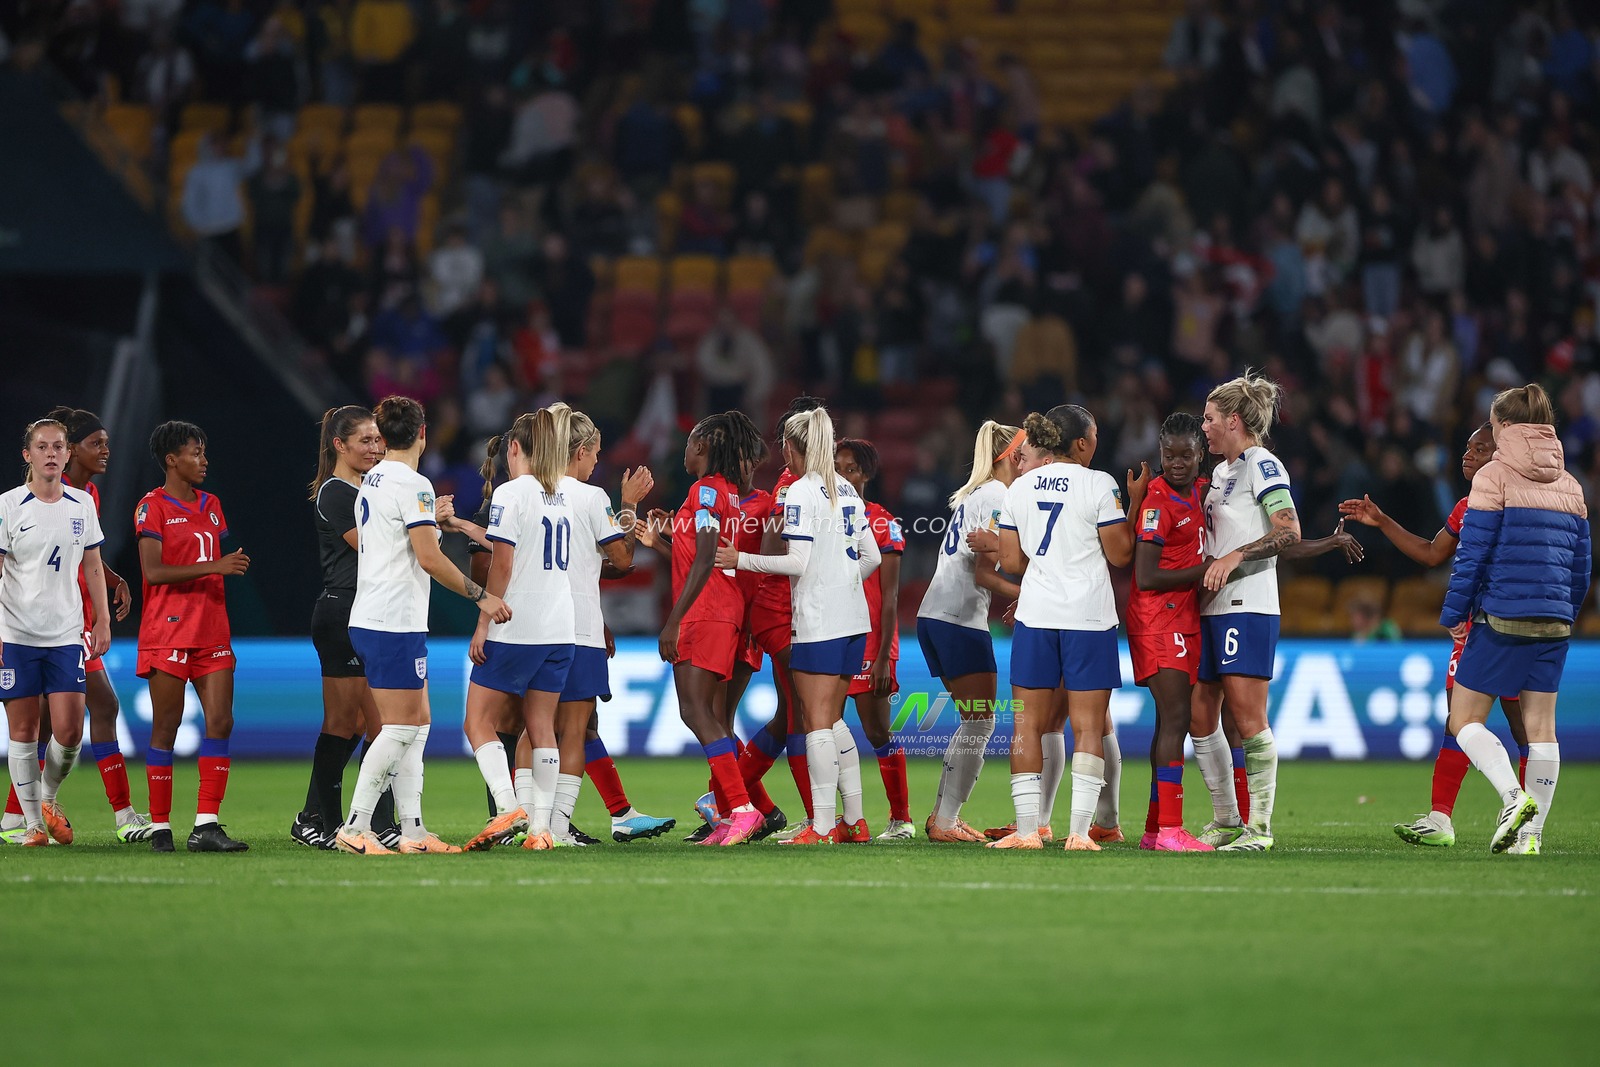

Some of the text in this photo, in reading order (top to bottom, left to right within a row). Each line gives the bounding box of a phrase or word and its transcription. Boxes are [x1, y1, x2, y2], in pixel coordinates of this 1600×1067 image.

[1034, 476, 1069, 492] JAMES
[541, 515, 571, 571] 10
[842, 505, 860, 560] 5
[941, 504, 965, 555] 8
[1036, 501, 1064, 556] 7
[47, 545, 61, 572] 4
[193, 531, 214, 563] 11
[1173, 632, 1188, 658] 9
[1225, 627, 1239, 656] 6
